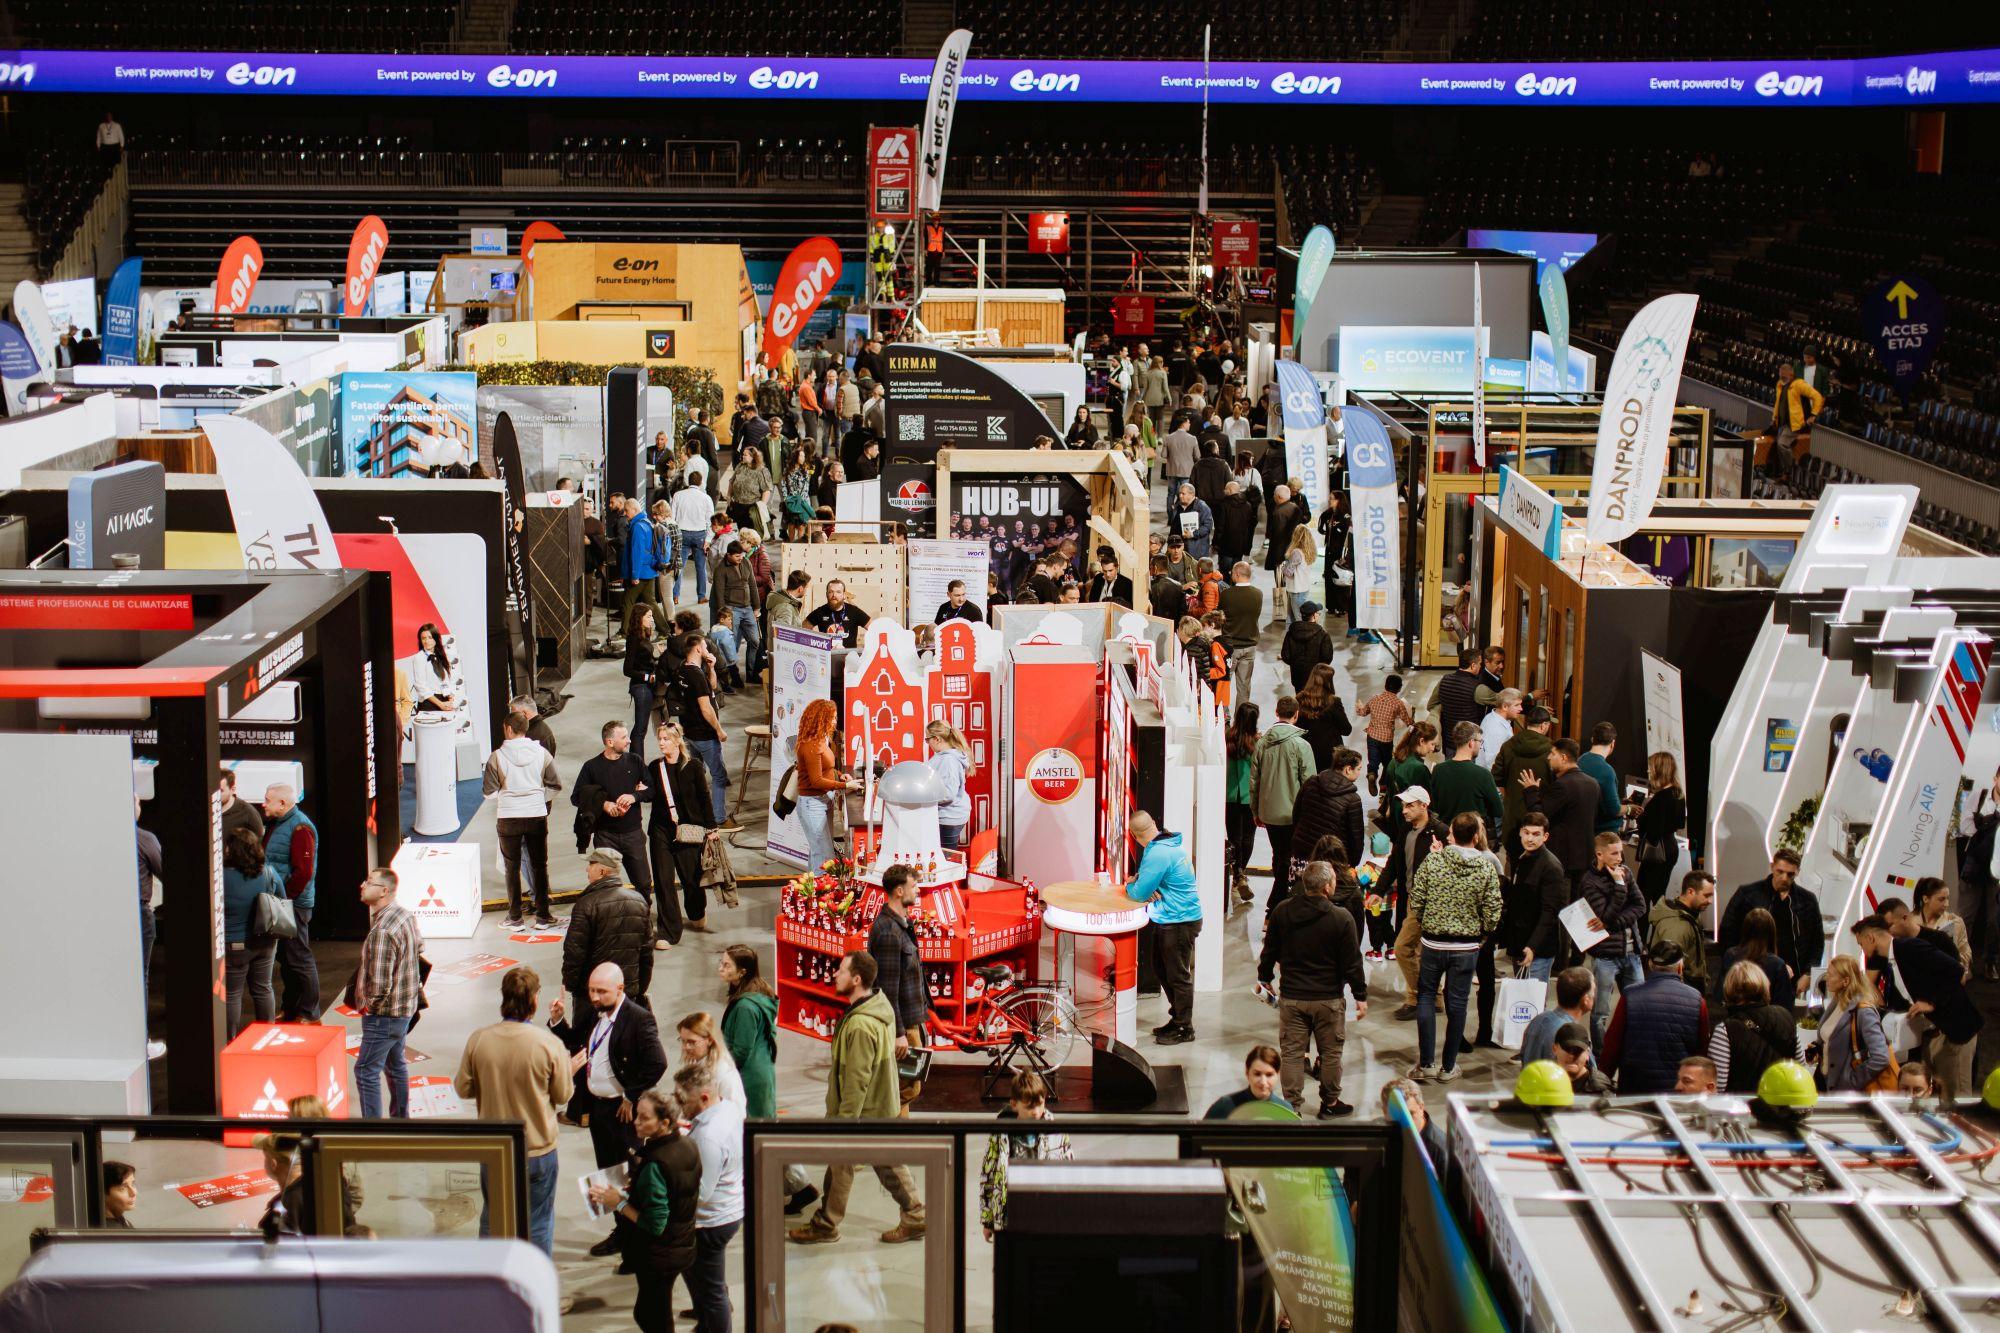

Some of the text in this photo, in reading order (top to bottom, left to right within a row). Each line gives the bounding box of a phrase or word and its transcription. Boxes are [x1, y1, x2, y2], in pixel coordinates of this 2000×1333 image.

[115, 66, 147, 78] Event
[149, 67, 199, 80] powered
[200, 67, 215, 80] by
[377, 68, 409, 80] Event
[411, 69, 459, 83] powered
[461, 69, 476, 83] by
[639, 70, 671, 82] Event
[673, 71, 721, 85] powered
[723, 71, 738, 85] by
[900, 74, 930, 85] Event
[984, 74, 999, 87] by
[1160, 75, 1193, 87] Event
[1195, 75, 1244, 89] powered
[1246, 76, 1261, 89] by
[1420, 77, 1450, 89] Event
[1451, 77, 1492, 91] powered
[1494, 77, 1506, 91] by
[1650, 77, 1680, 89] Event
[1682, 77, 1728, 92] powered
[1730, 77, 1745, 92] by
[934, 48, 960, 148] BIG STORE
[881, 190, 905, 198] HEAVY
[881, 198, 905, 206] DUTY
[596, 276, 676, 286] Future Energy Home
[111, 309, 131, 319] TERA
[249, 303, 294, 314] DAIK
[111, 317, 131, 326] PLAST
[1881, 323, 1929, 338] ACCES
[655, 337, 667, 347] BT
[1888, 336, 1922, 350] ETAJ
[1385, 349, 1466, 364] ECOVENT
[889, 357, 937, 370] KIRMAN
[1496, 368, 1522, 377] ECOVENT
[387, 401, 433, 412] ventilate
[435, 402, 470, 413] pentru
[351, 414, 365, 422] un
[367, 412, 394, 422] viitor
[1606, 397, 1644, 522] DANPROD
[911, 498, 937, 506] LEMNULU
[961, 486, 1064, 518] HUB-UL
[1516, 492, 1541, 530] DANPROD
[967, 549, 986, 557] work
[38, 599, 110, 609] PROFESIONALE
[112, 600, 125, 609] DE
[127, 600, 190, 609] CLIMATIZARE
[810, 638, 829, 649] work
[1034, 767, 1076, 777] AMSTEL
[1044, 780, 1066, 788] BEER
[1086, 912, 1113, 925] 100%
